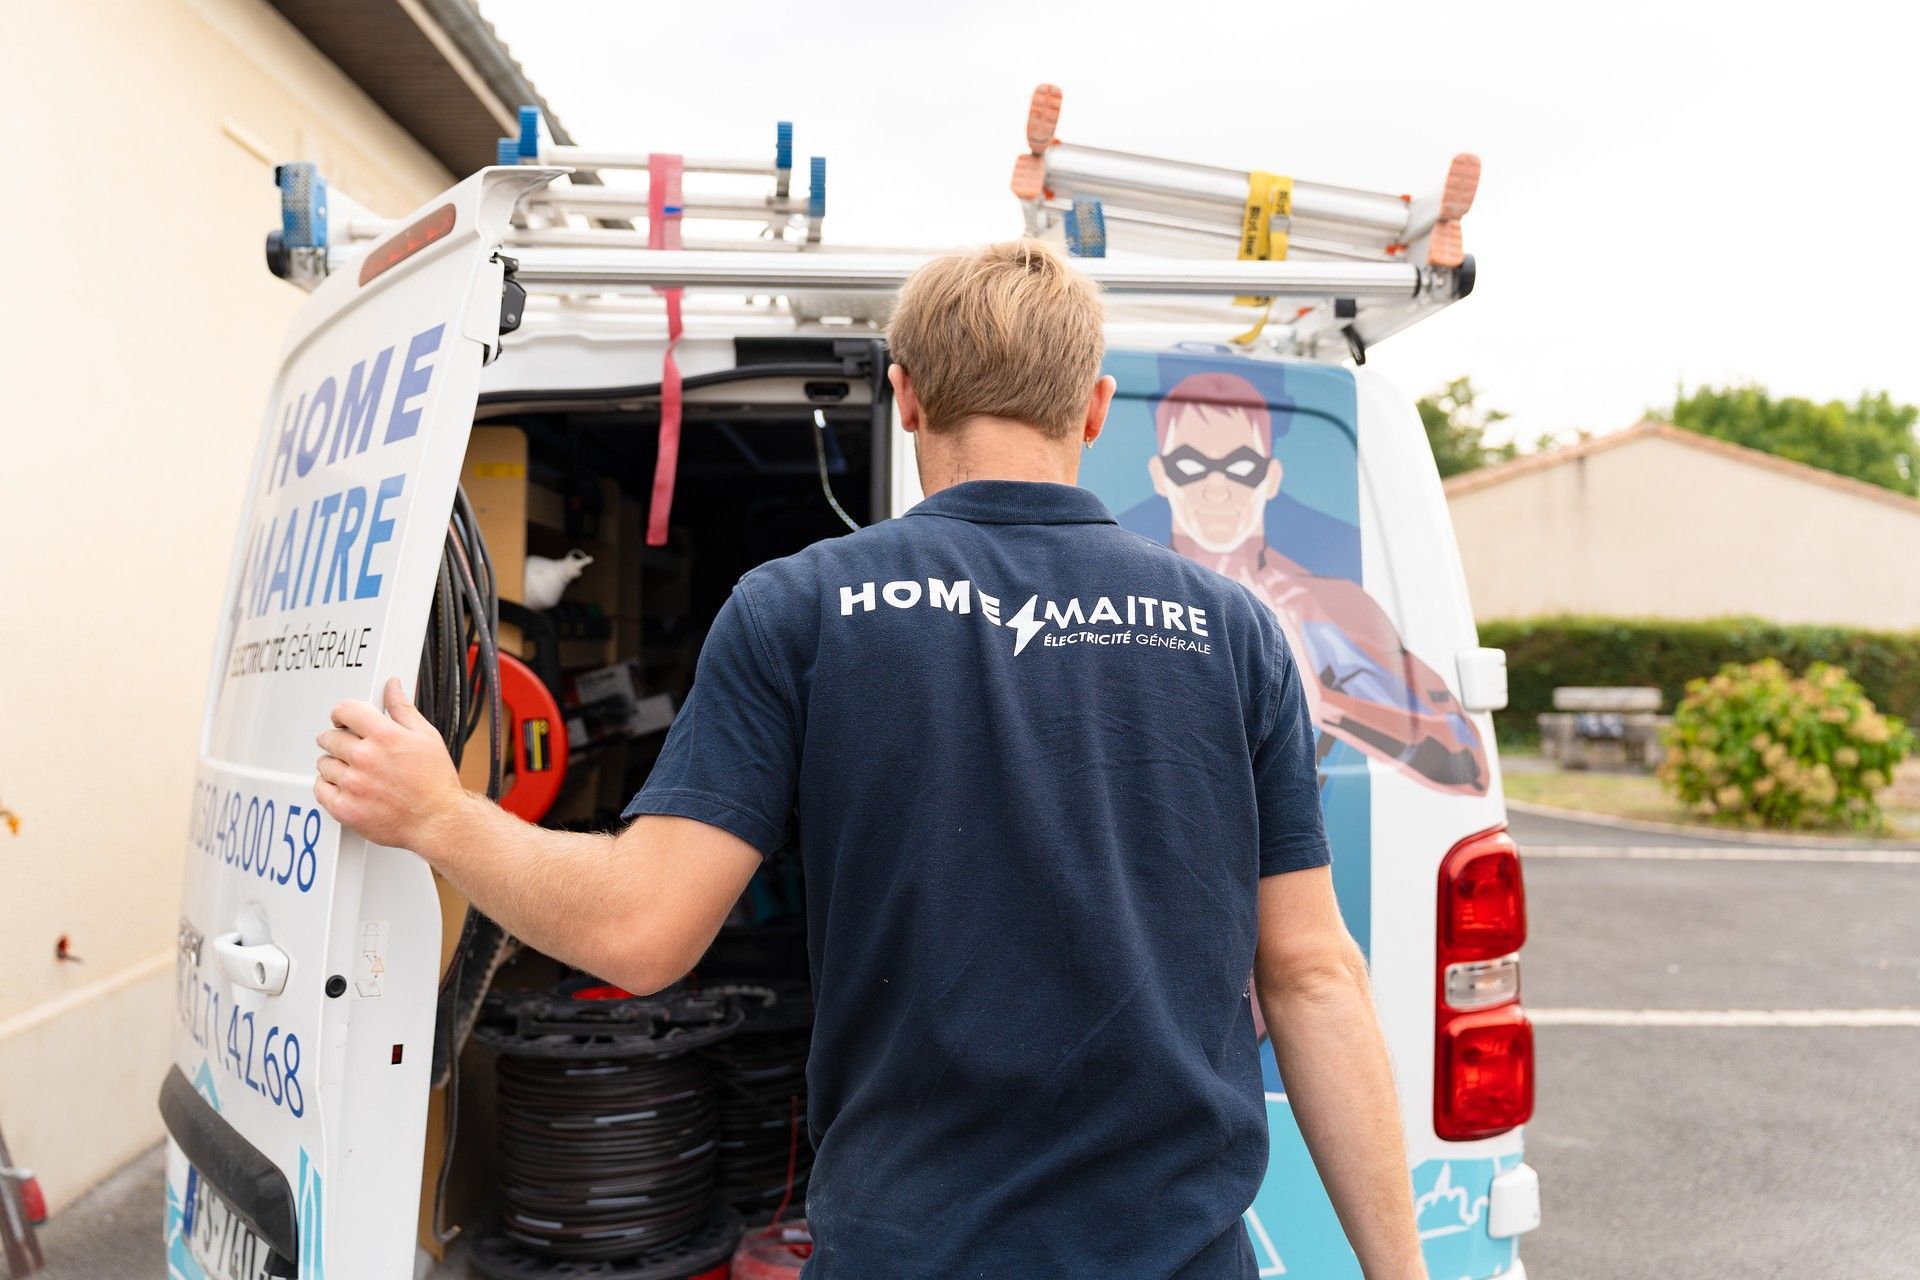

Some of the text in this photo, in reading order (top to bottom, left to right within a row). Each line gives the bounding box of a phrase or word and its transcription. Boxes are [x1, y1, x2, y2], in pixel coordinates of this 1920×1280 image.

[267, 322, 446, 496] HOME
[248, 473, 406, 620] MAITRE
[839, 577, 1209, 637] HOME MAITRE
[284, 620, 372, 671] GÉNÉRALE
[1043, 630, 1212, 655] ÉLECTRICITÉ GÉNÉRALE
